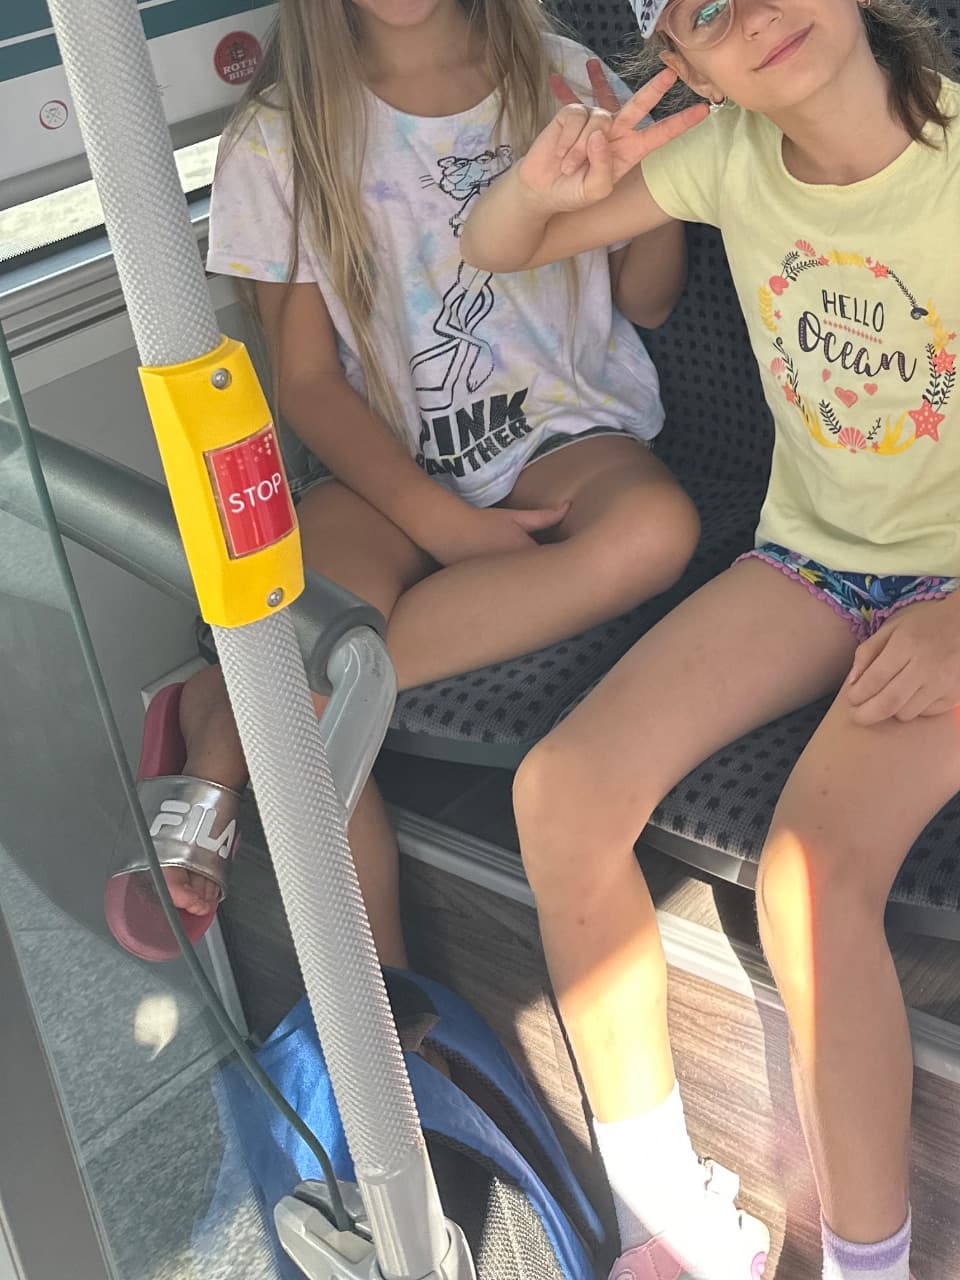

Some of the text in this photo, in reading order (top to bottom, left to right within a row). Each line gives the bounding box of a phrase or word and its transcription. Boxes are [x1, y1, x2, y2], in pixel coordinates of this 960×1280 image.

[821, 289, 885, 333] HELLO
[798, 311, 917, 383] Ocean
[228, 472, 282, 514] STOP
[150, 799, 237, 859] FILA
